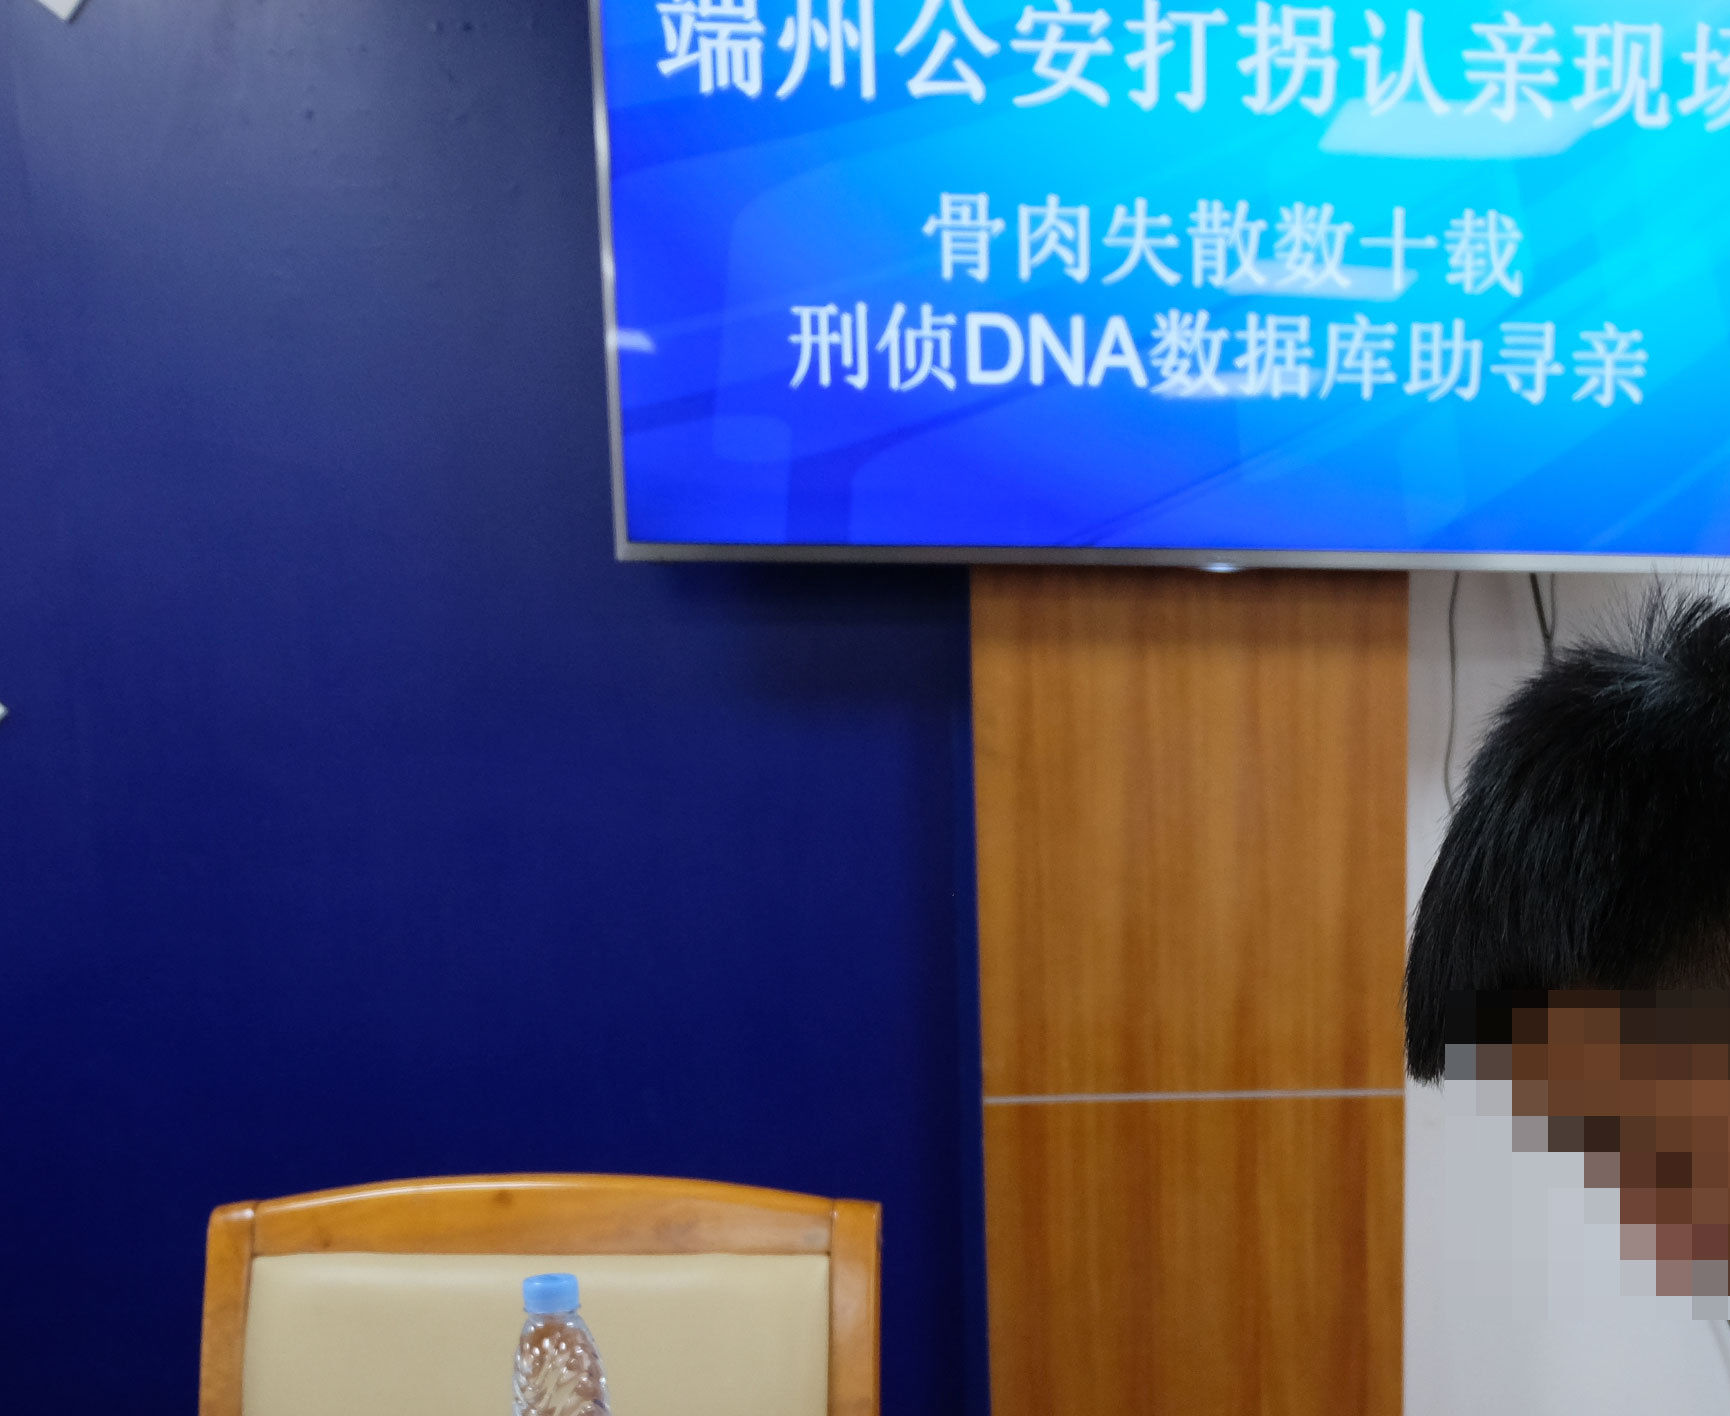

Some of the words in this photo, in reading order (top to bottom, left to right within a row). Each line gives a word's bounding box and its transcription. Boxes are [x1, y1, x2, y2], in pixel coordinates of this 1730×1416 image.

[923, 193, 1525, 298] 骨肉失散数十载
[788, 301, 1651, 407] 刑侦DNA数据库助寻亲
